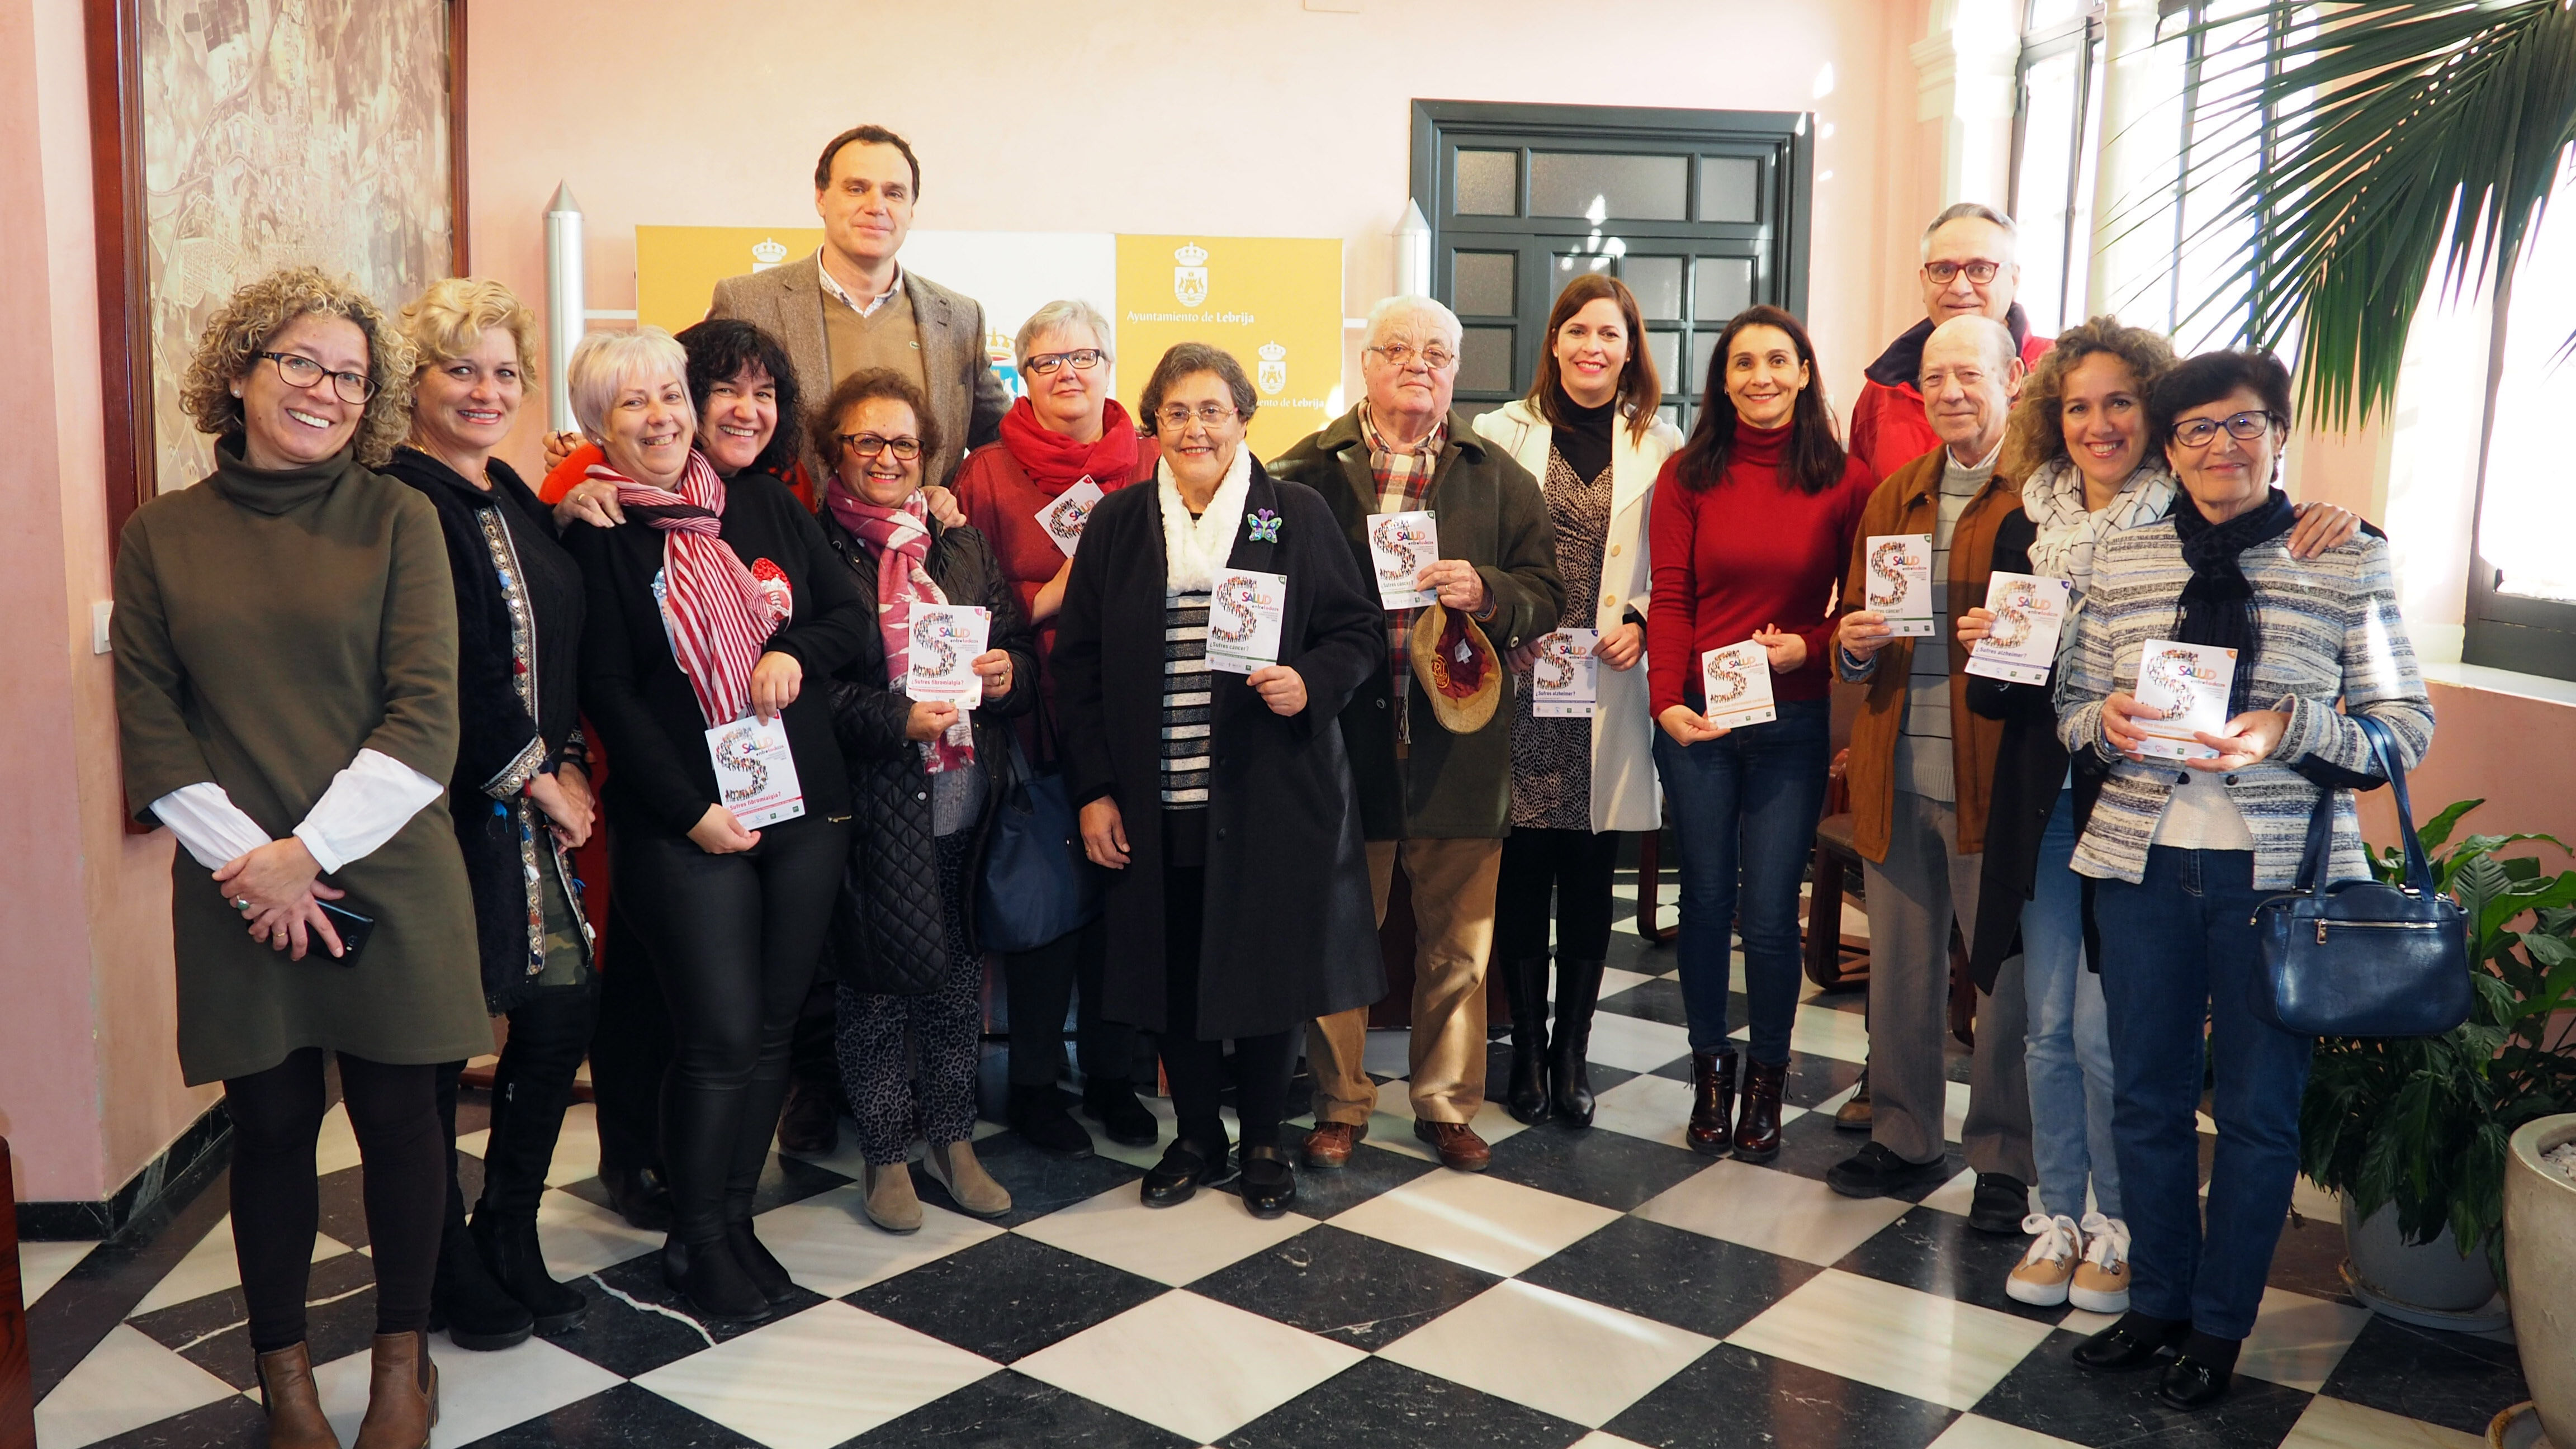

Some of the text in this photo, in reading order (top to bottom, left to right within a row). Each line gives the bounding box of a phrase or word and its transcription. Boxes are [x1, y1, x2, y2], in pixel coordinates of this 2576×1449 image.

[1126, 310, 1254, 326] Ayuntamiento de Lebrija
[1280, 397, 1291, 408] de
[1292, 397, 1324, 410] Lebrija
[1069, 499, 1095, 522] SALUD
[1397, 531, 1426, 541] SALUD
[1893, 556, 1920, 566] SALUD
[1242, 591, 1272, 604] SALUD
[2018, 596, 2051, 610] SALUD
[939, 627, 970, 637] SALUD
[1560, 645, 1587, 655] SALUD
[1729, 656, 1756, 669] SALUD
[2178, 665, 2217, 680] SALUD
[742, 737, 774, 754] SALUD
[748, 791, 782, 806] fibromialgia?
